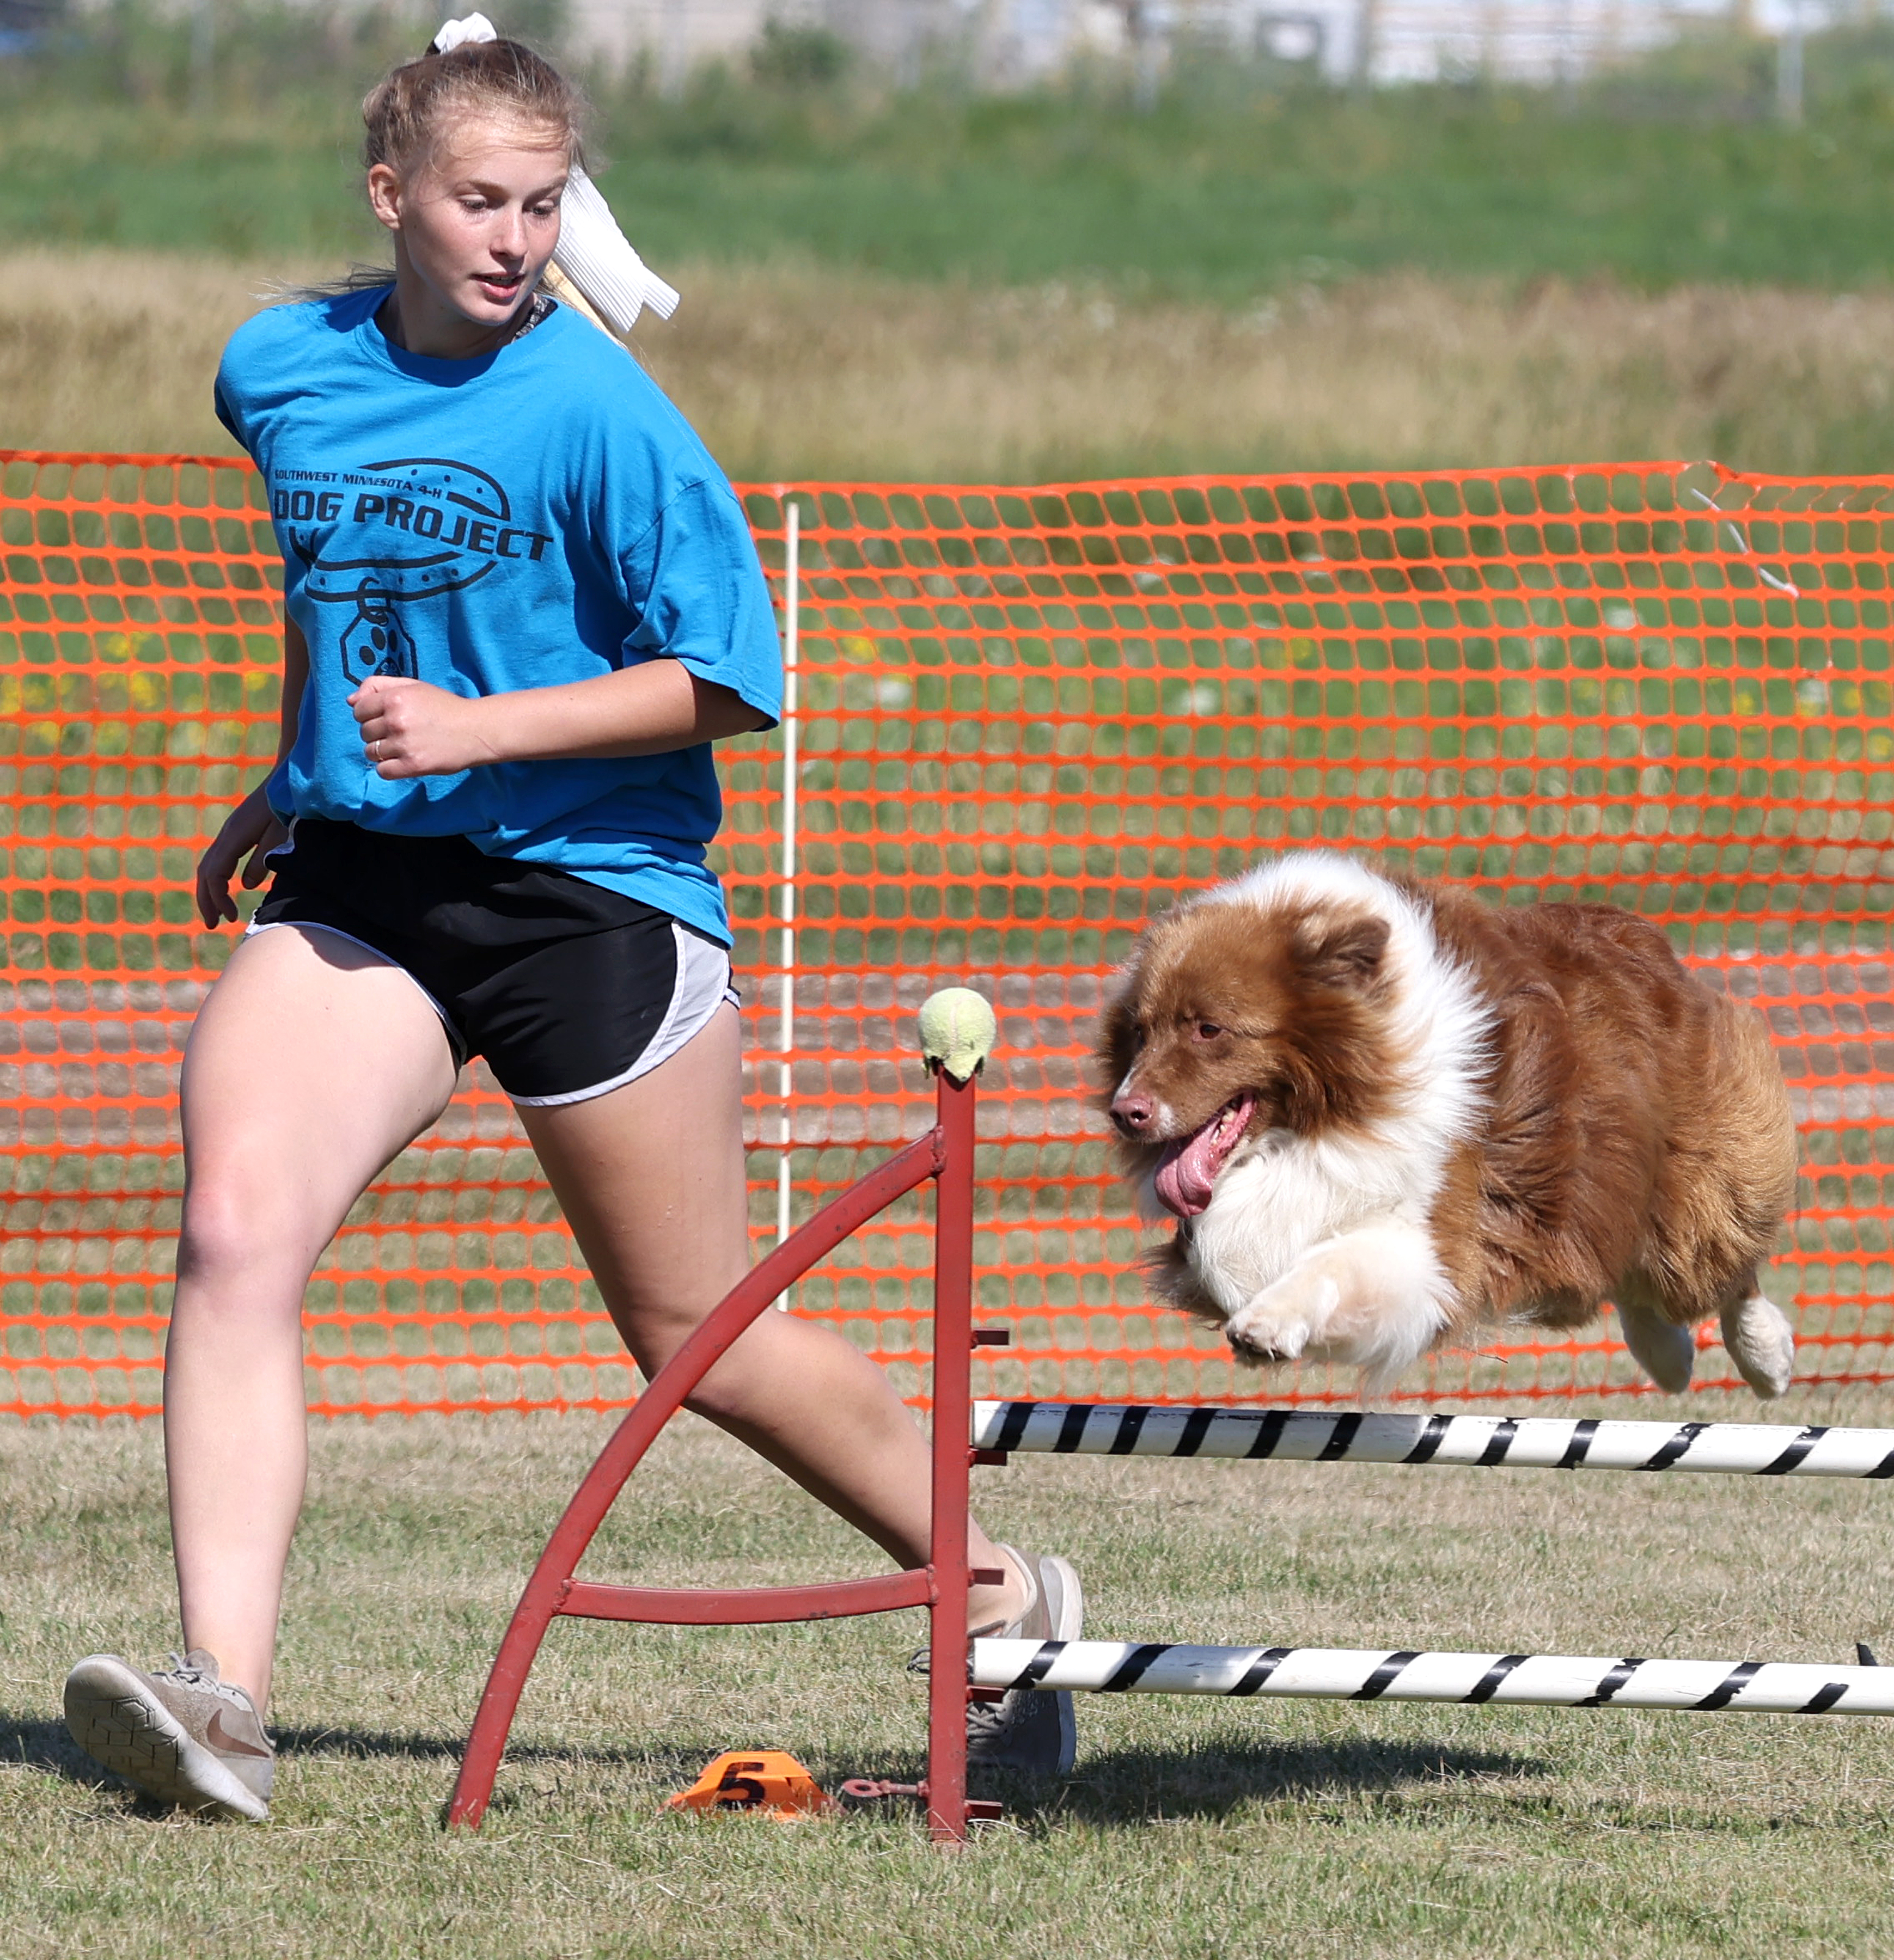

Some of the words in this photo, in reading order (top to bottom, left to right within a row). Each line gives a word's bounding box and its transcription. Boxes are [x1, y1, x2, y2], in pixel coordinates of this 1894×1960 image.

[274, 469, 339, 482] SOUTHWEST
[342, 473, 413, 491] MINNESOTA
[418, 485, 442, 499] 4-H
[274, 489, 345, 522] DOG
[353, 493, 554, 562] PROJECT
[717, 1761, 765, 1809] 5
